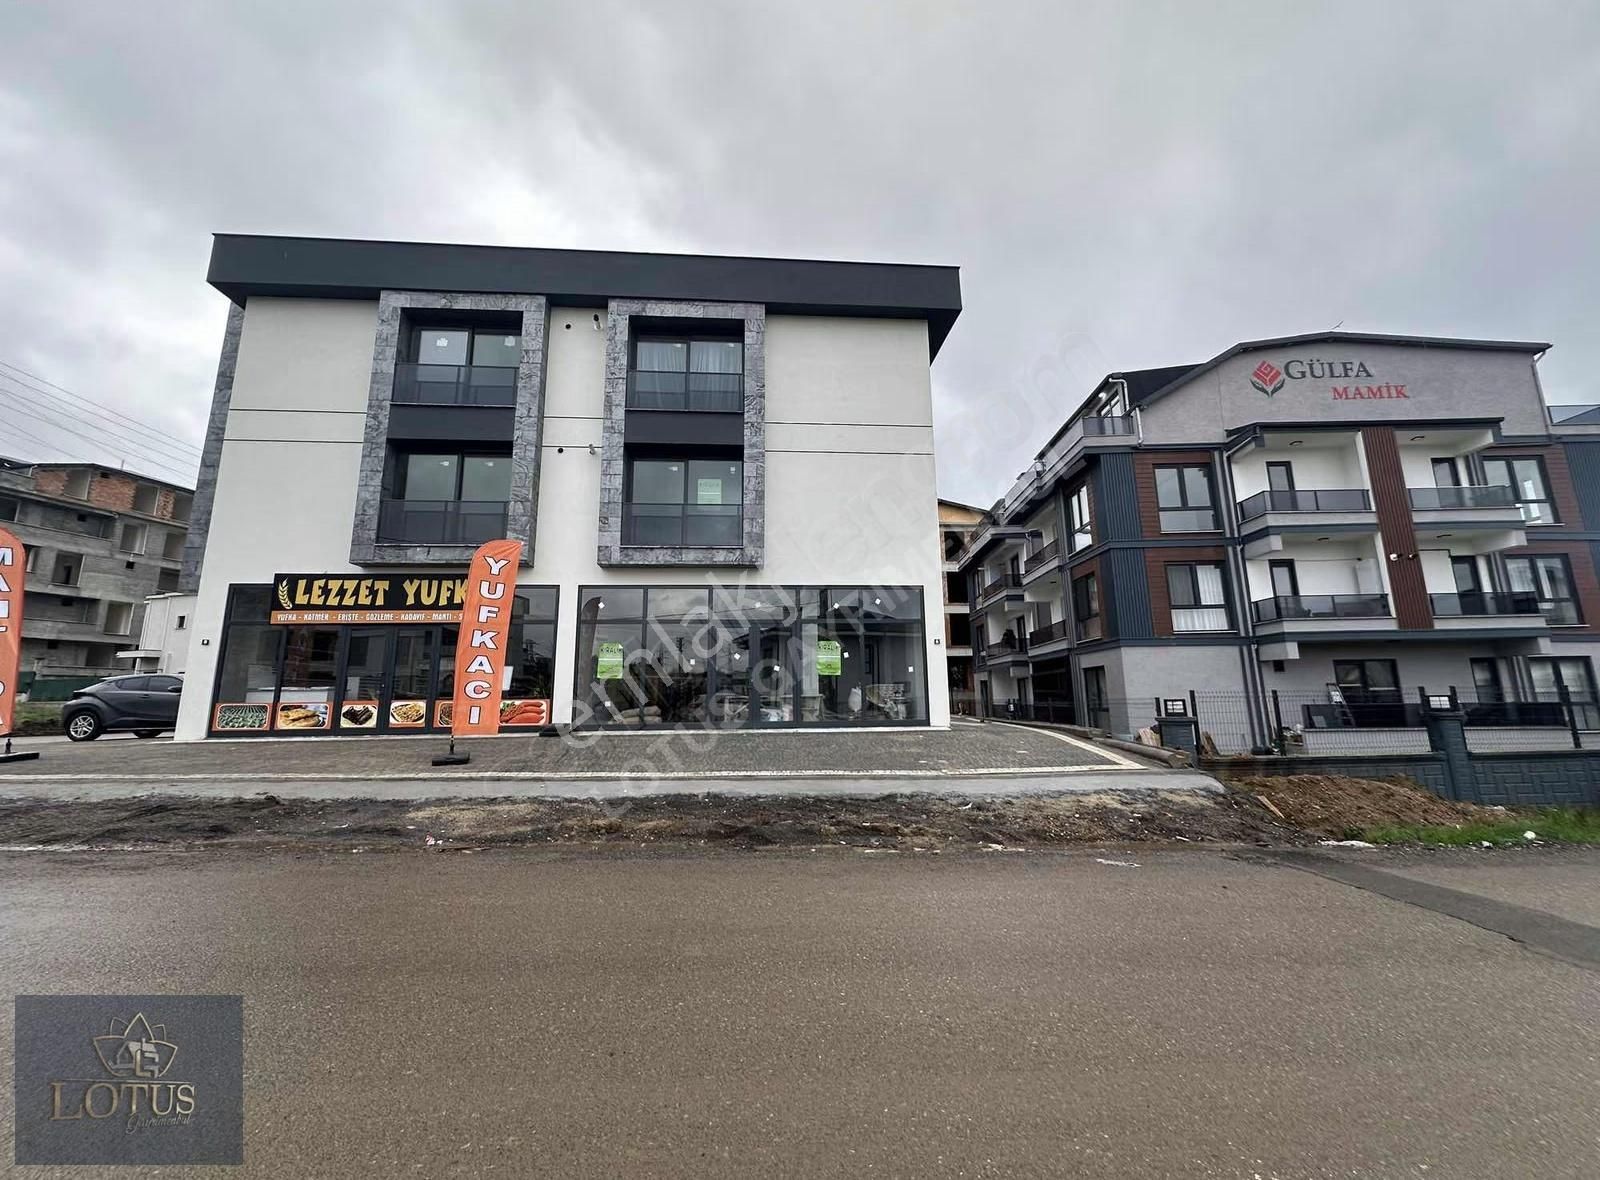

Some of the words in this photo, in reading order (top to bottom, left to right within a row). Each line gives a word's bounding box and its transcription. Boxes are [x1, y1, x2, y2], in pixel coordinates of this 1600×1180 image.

[1283, 358, 1374, 380] GÜLFA
[1331, 381, 1409, 401] MAMİK
[295, 578, 390, 606] LEZZET
[463, 555, 511, 725] YUFKACI
